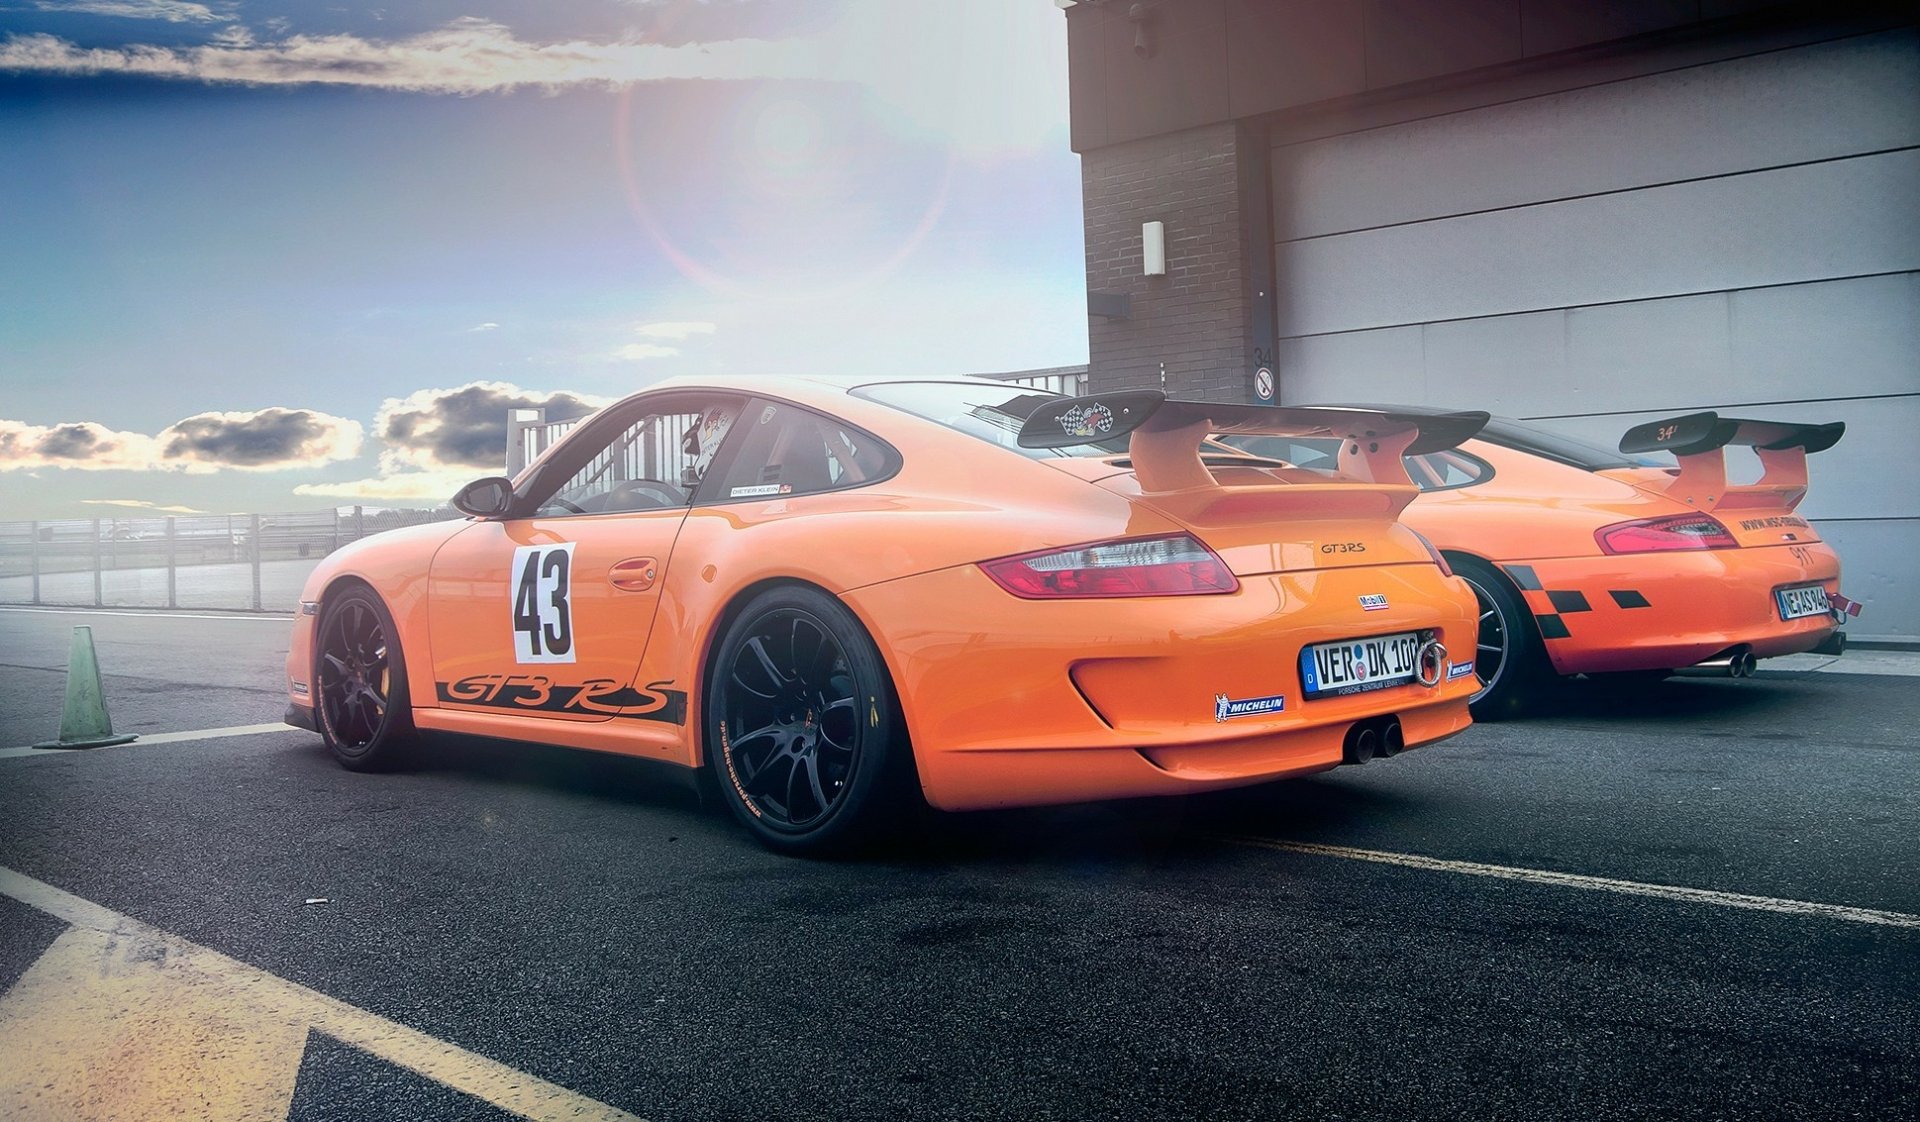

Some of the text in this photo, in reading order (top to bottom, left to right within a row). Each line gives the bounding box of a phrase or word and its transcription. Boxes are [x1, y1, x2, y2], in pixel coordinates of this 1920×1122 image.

[1254, 347, 1272, 367] 34
[758, 486, 779, 494] KLEIN
[1788, 546, 1815, 567] 911
[514, 548, 572, 656] 43
[1315, 645, 1356, 685] VER
[1366, 641, 1390, 678] DK
[447, 675, 552, 706] GT3
[1338, 686, 1361, 696] PORSCHE
[1362, 681, 1384, 692] ZENTRUM
[1230, 698, 1283, 713] MICHELIN
